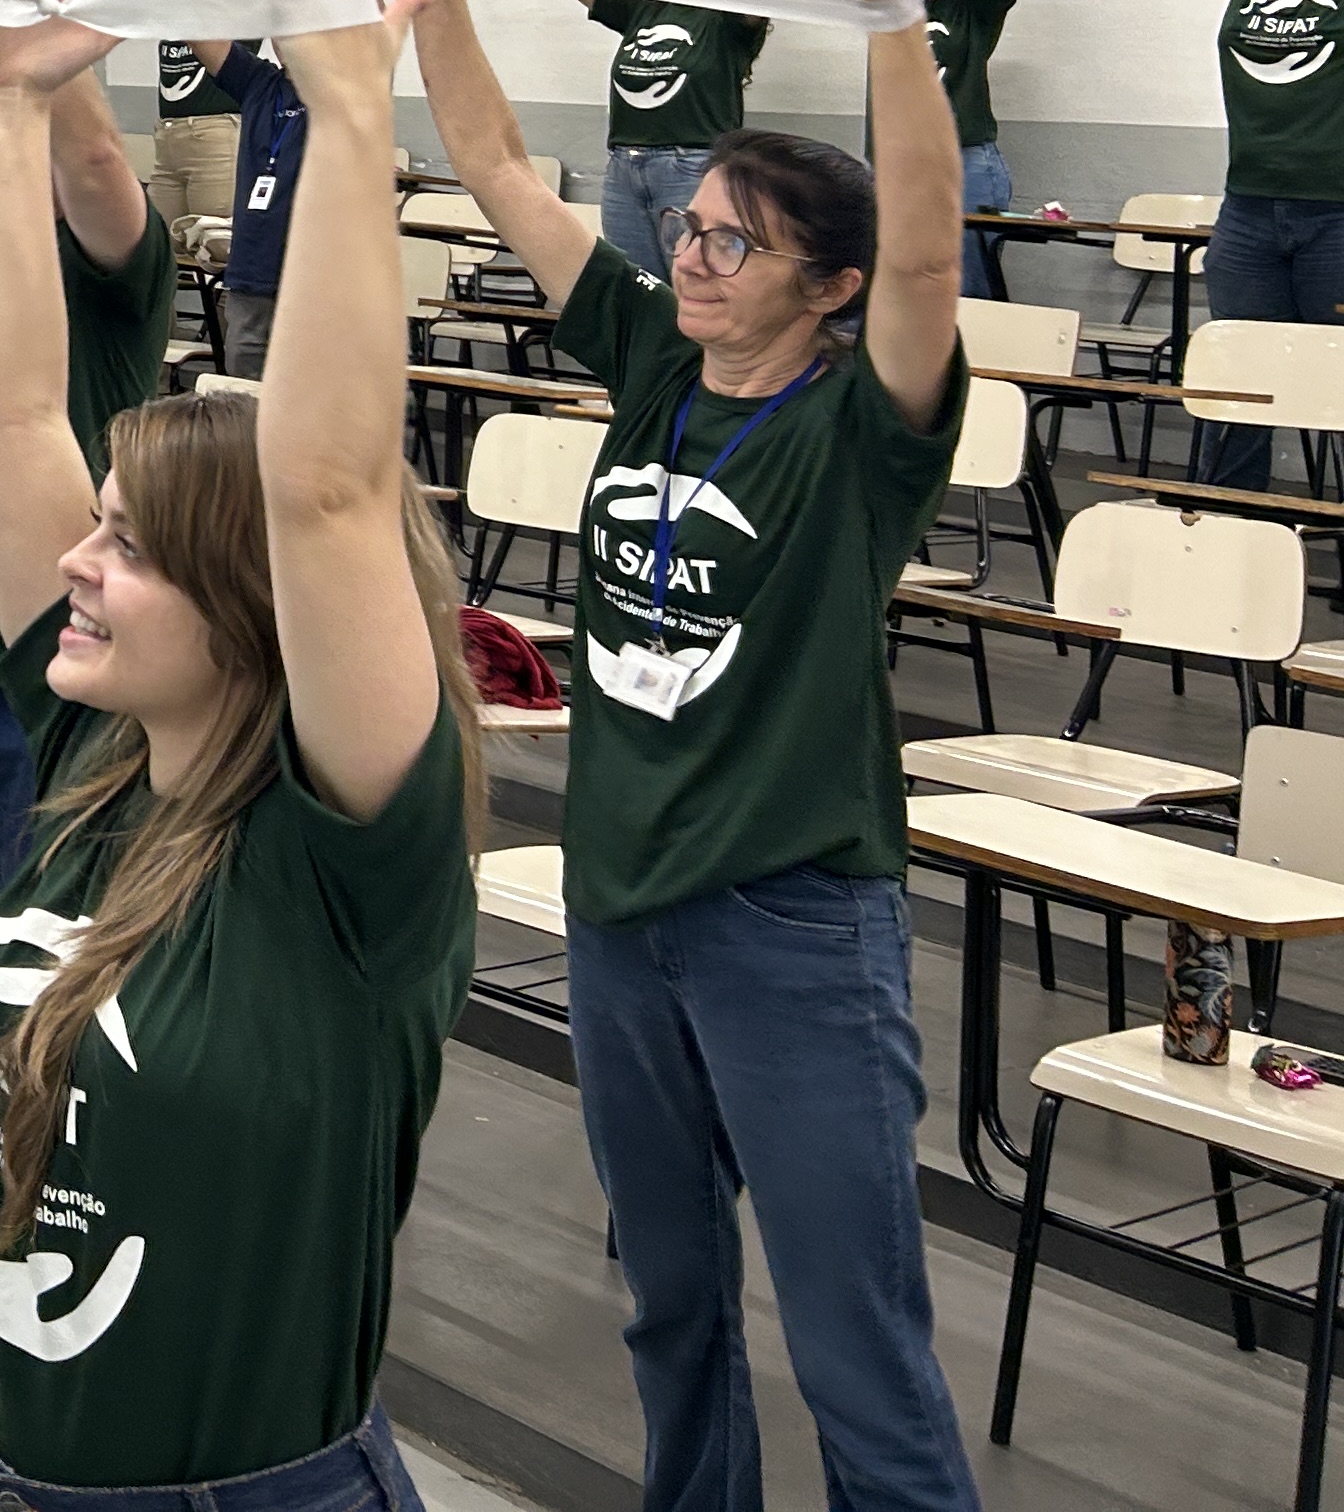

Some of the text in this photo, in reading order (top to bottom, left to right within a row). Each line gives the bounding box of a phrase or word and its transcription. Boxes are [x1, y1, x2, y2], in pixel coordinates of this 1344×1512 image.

[1247, 15, 1320, 34] II SIPAT
[593, 524, 608, 562] II
[662, 615, 677, 627] de
[43, 1184, 105, 1216] evenção
[35, 1205, 88, 1234] abalho
